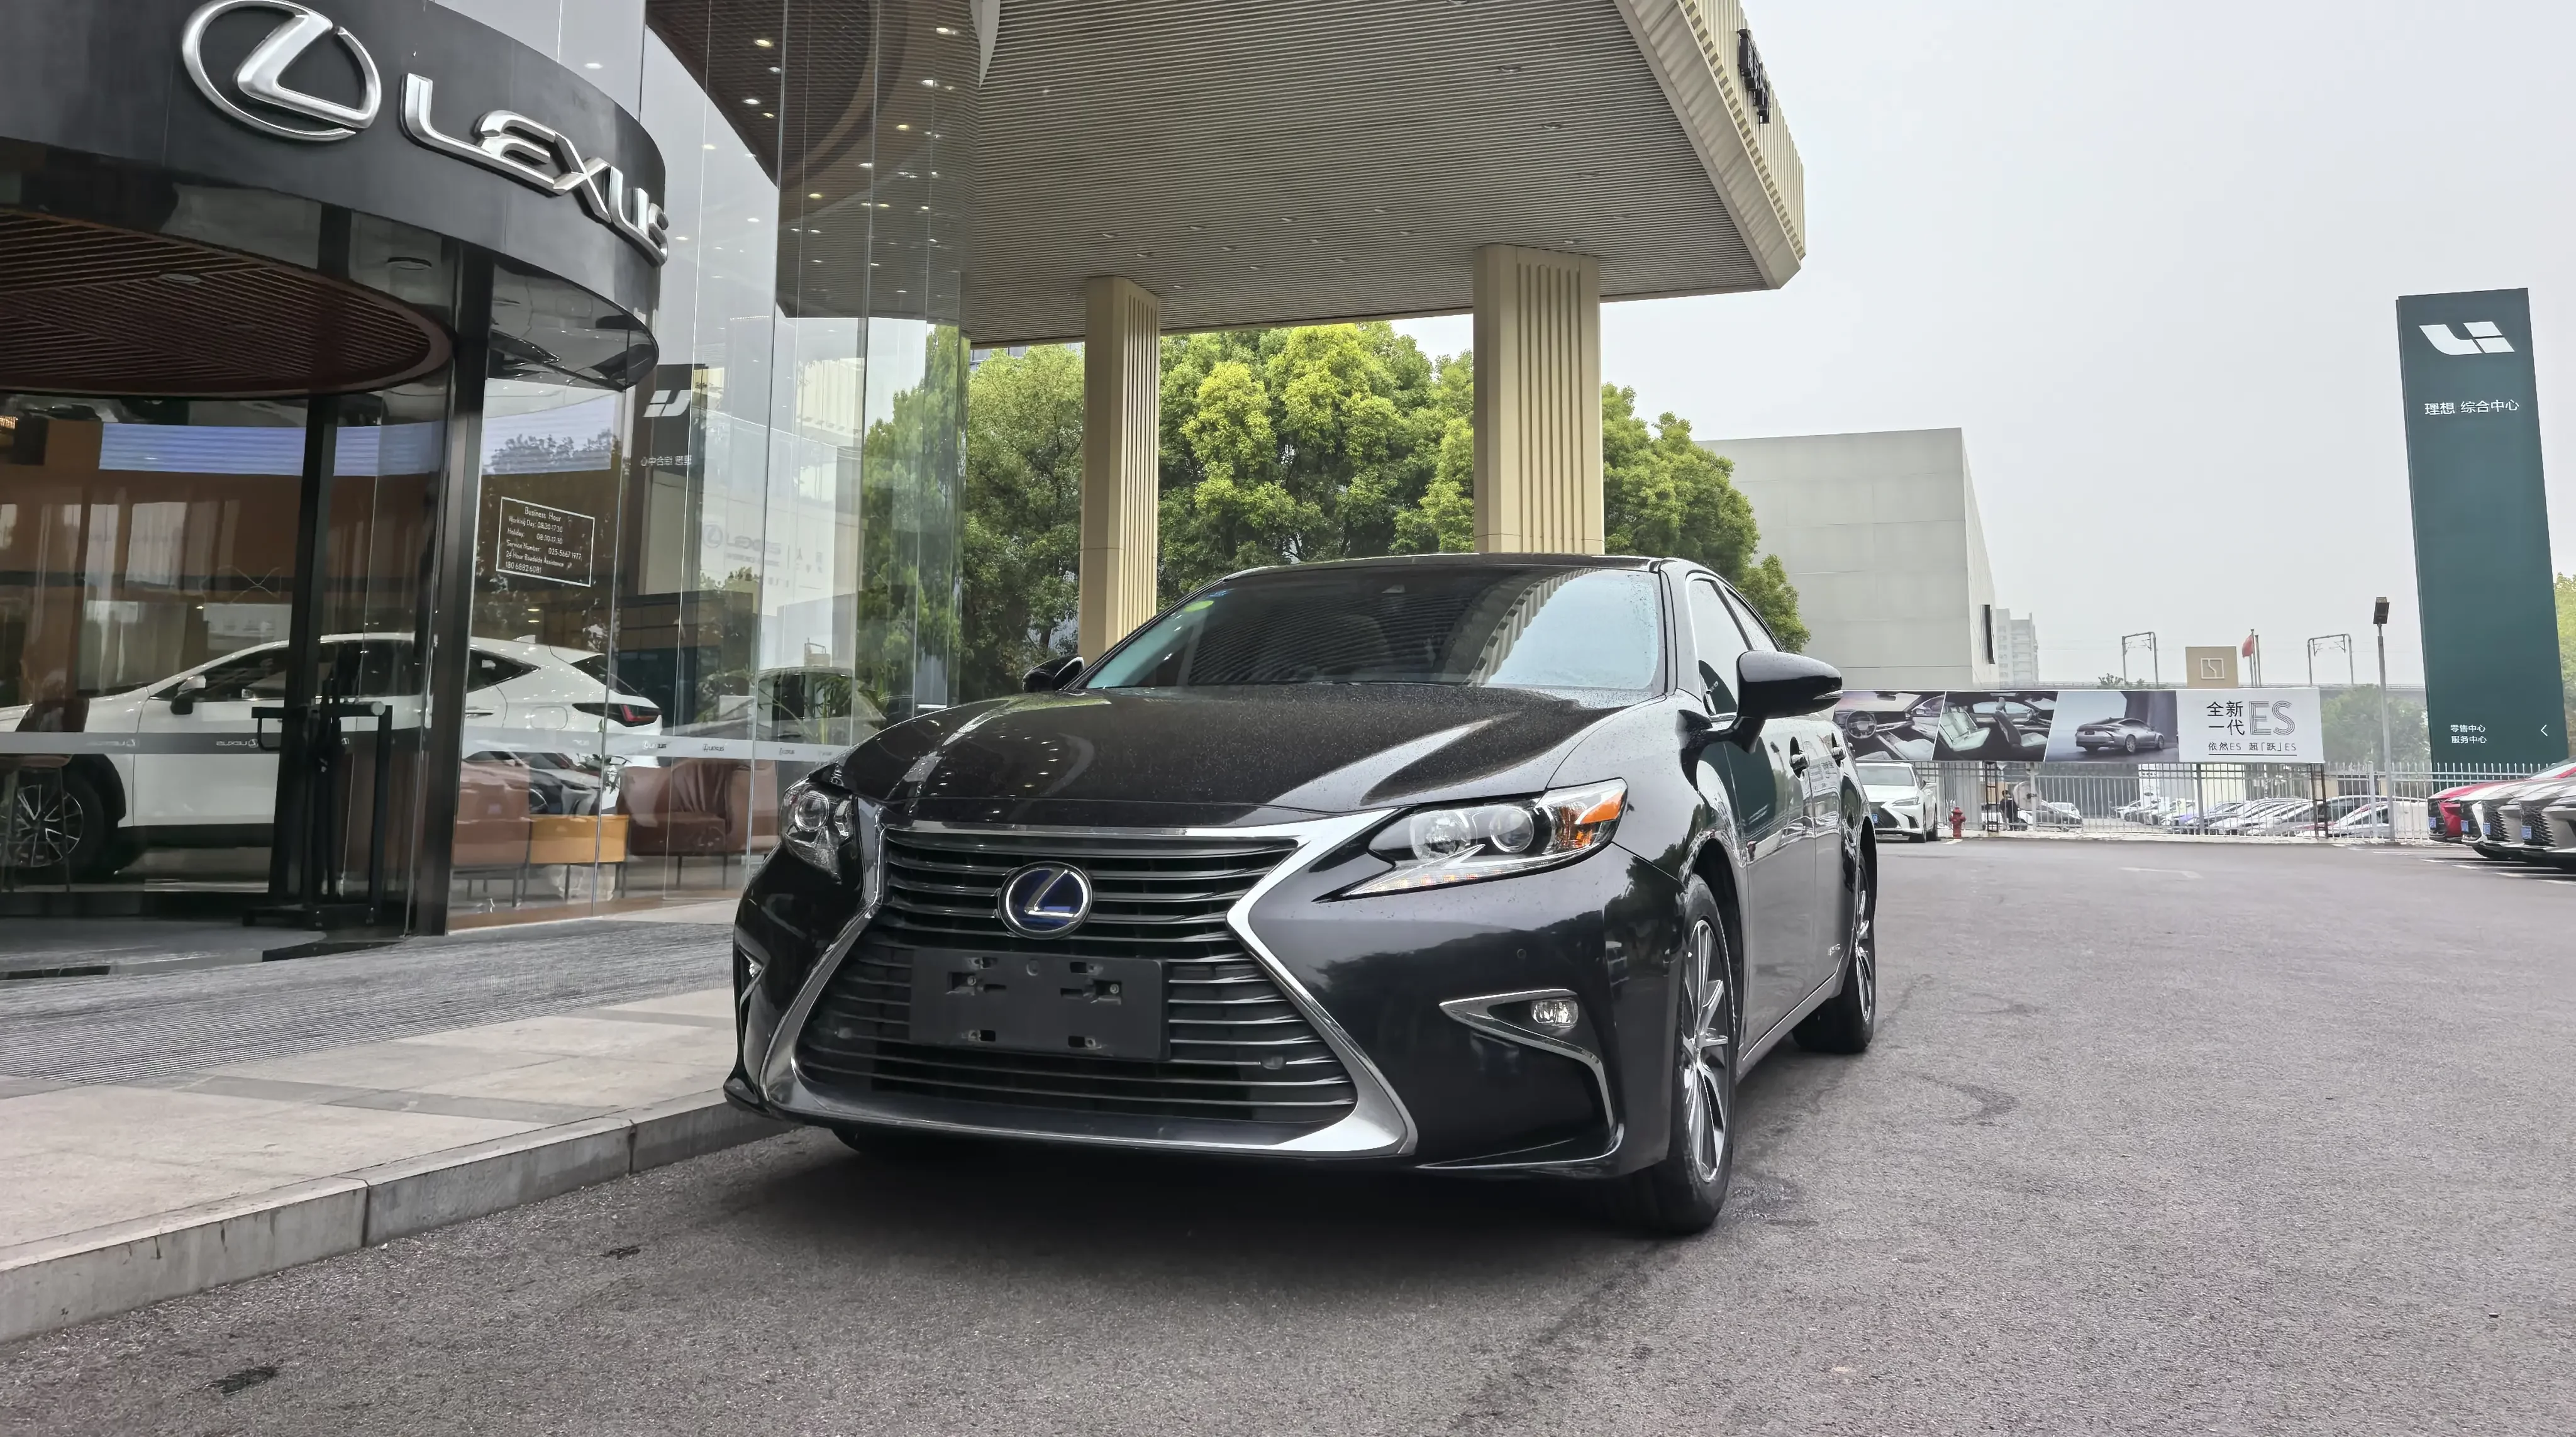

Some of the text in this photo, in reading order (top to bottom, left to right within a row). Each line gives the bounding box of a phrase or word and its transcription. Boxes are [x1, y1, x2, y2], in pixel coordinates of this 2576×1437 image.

[399, 72, 667, 267] LEXUS
[2424, 399, 2519, 415] 理想 综合中心
[525, 506, 562, 521] Business Hour
[2206, 700, 2243, 718] 全新
[2248, 700, 2296, 736] ES
[2208, 719, 2245, 736] 一代
[2450, 724, 2486, 733] 零售中心
[2451, 735, 2487, 743] 服务中心
